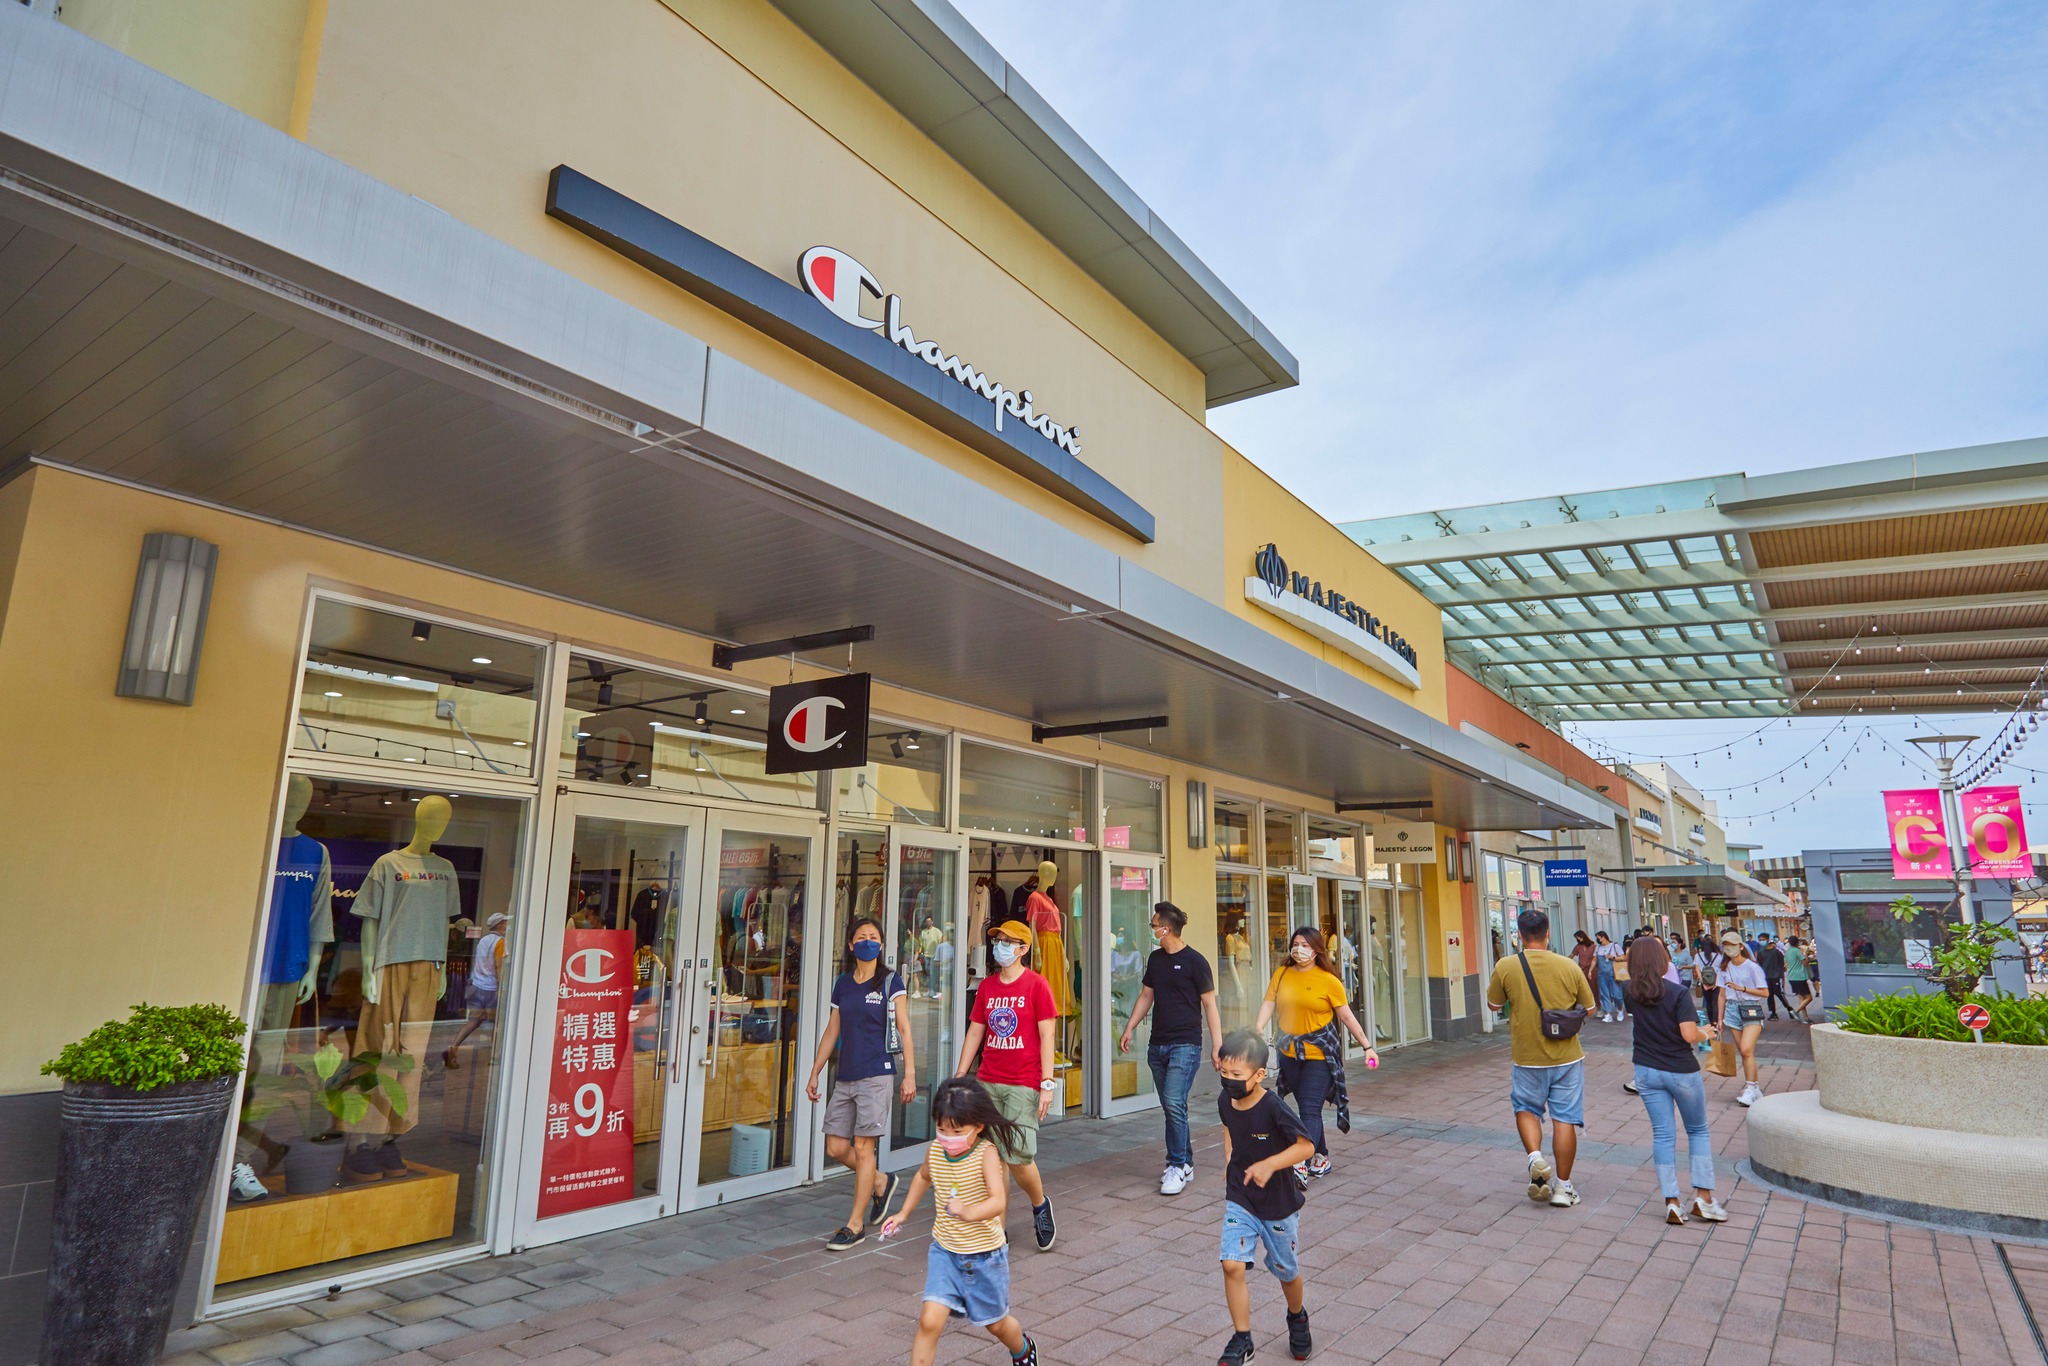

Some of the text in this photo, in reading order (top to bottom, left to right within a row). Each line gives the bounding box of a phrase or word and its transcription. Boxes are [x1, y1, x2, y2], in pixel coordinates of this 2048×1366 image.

[797, 245, 1082, 456] Champion
[1291, 571, 1418, 671] MAJESTIC LEGON
[1149, 780, 1161, 790] 216
[1973, 805, 2010, 813] NEW
[1894, 815, 1947, 863] G
[1972, 813, 2021, 862] O
[558, 987, 622, 1001] Champion
[986, 996, 1025, 1009] ROOTS
[562, 1011, 616, 1041] 精選
[987, 1034, 1025, 1050] CANADA
[561, 1043, 616, 1073] 特惠
[548, 1102, 570, 1115] 3件
